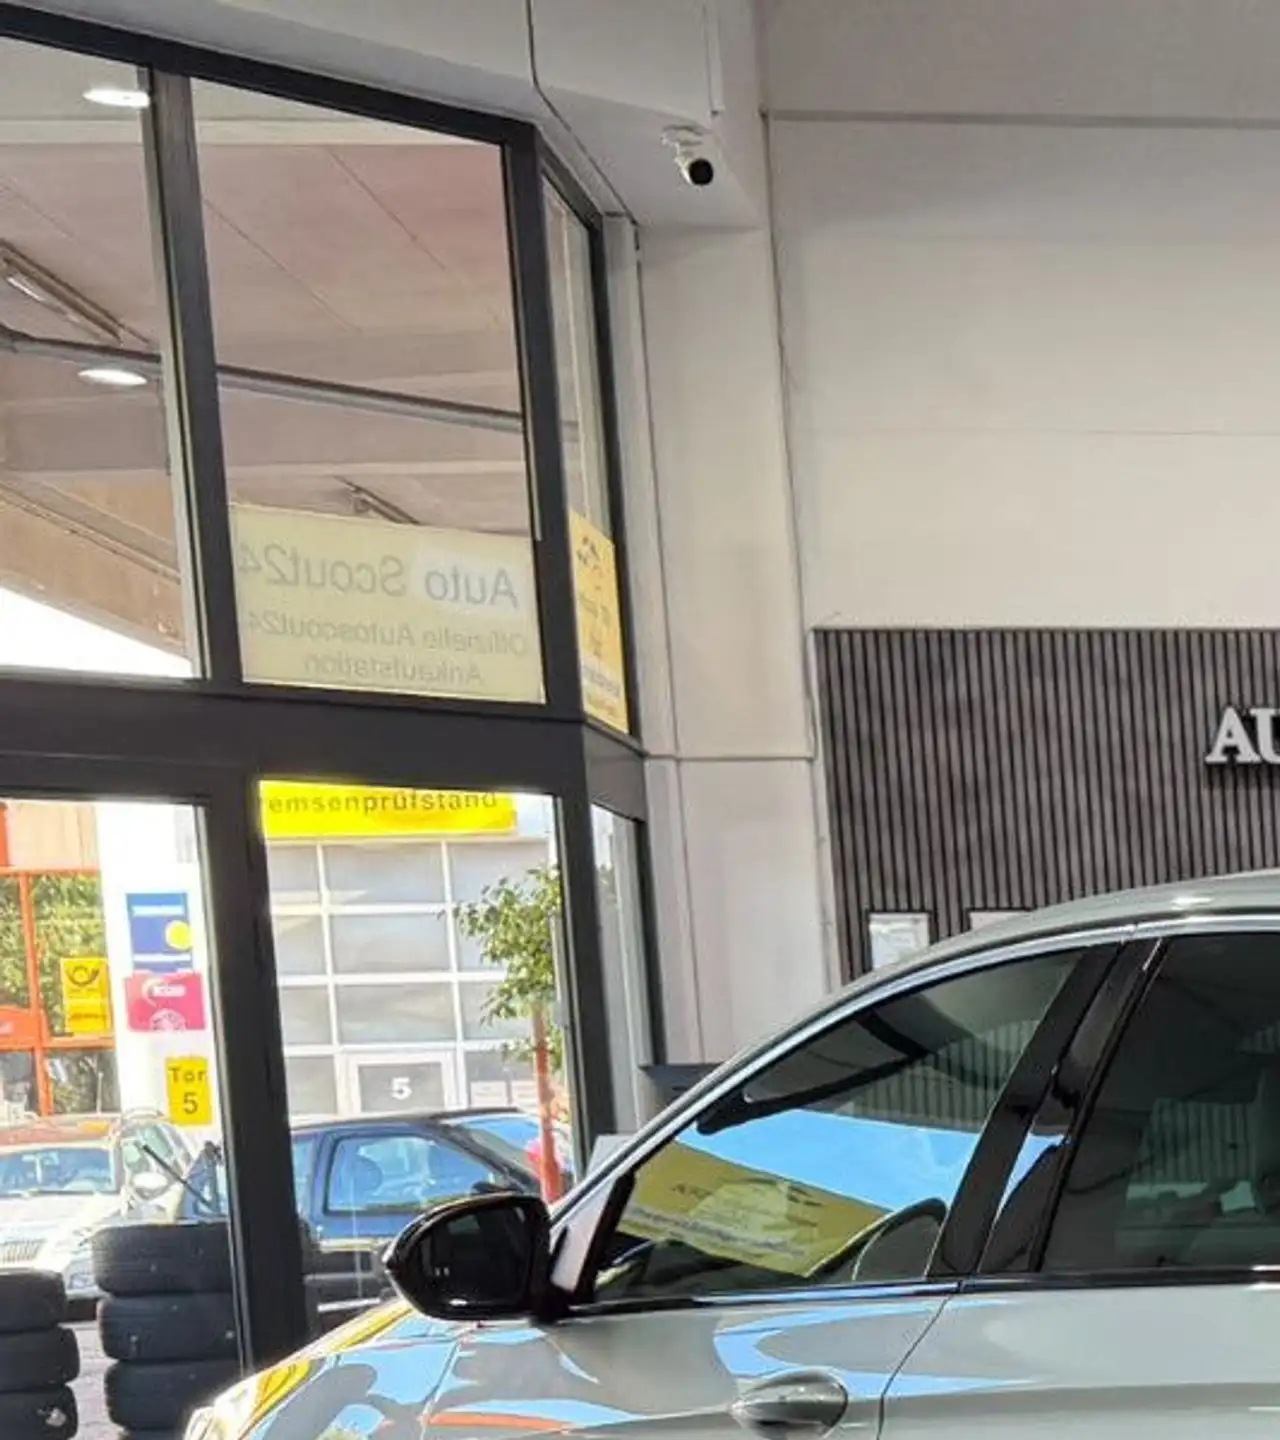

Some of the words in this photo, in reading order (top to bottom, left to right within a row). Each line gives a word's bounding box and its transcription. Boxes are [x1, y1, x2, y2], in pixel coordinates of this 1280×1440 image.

[260, 790, 498, 817] emsenprüfstand
[169, 1066, 207, 1082] Tor
[390, 1077, 413, 1100] 5
[182, 1091, 199, 1115] 5
